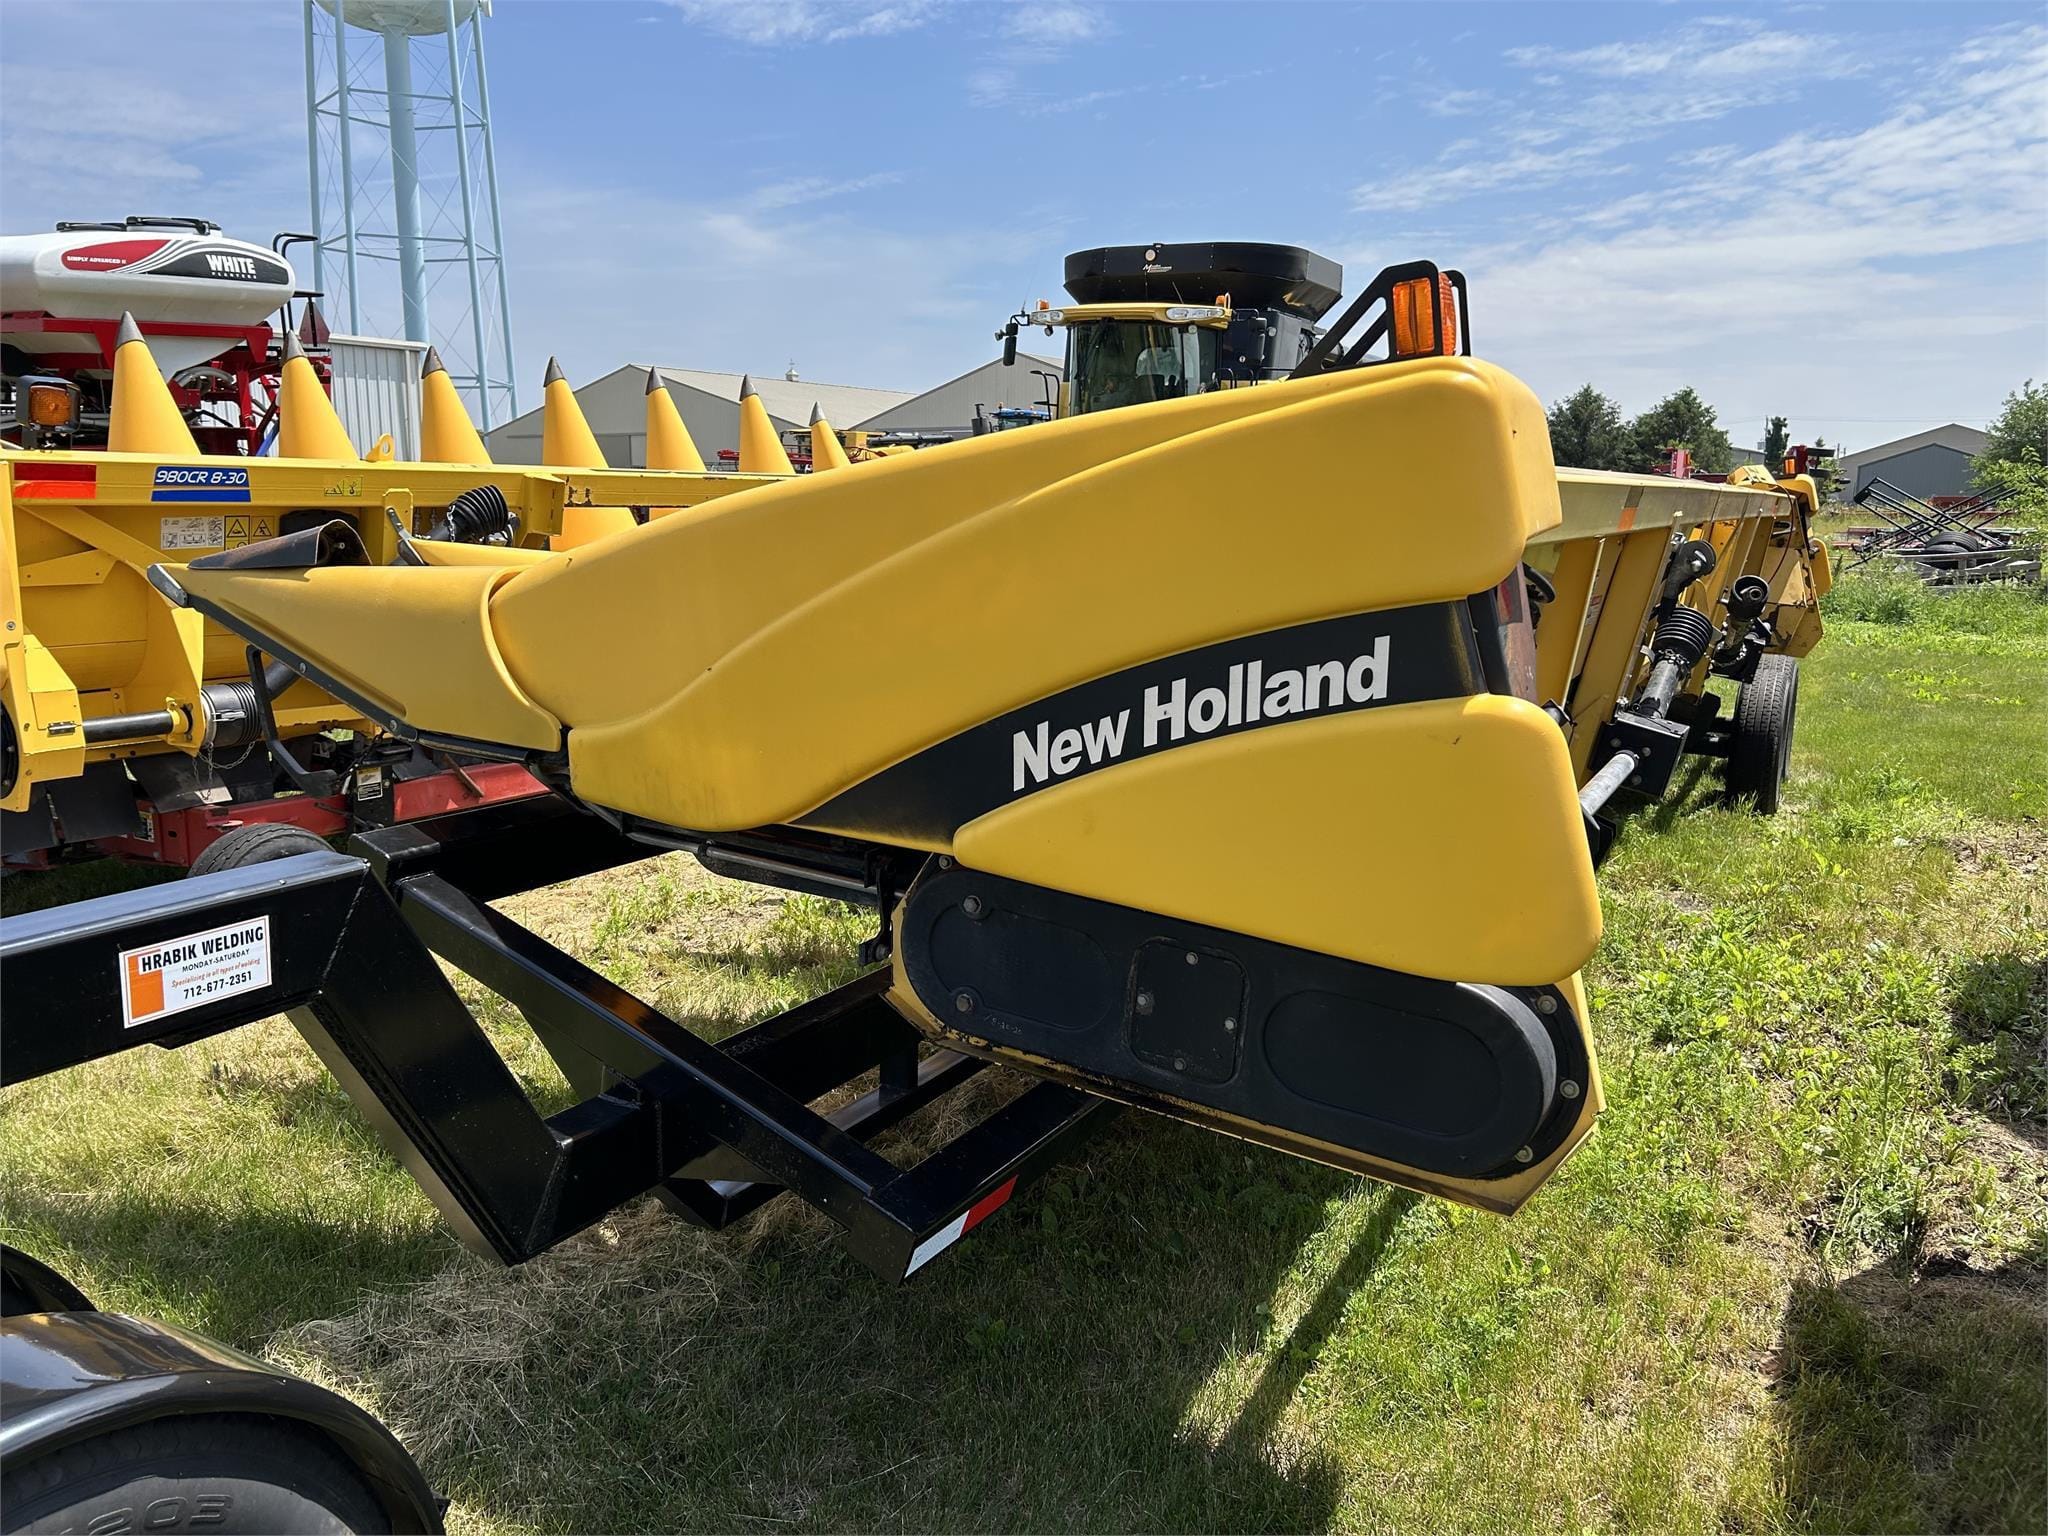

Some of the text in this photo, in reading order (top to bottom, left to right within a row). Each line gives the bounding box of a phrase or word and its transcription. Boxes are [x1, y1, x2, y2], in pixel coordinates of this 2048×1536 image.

[205, 254, 257, 274] WHITE
[155, 470, 247, 484] 980CR 8-30
[1013, 635, 1391, 792] New Holland
[141, 926, 264, 973] HRABIK WELDING
[182, 948, 250, 972] MONDAY-SATURDAY
[171, 973, 206, 989] Specializing
[212, 968, 220, 976] all
[240, 957, 261, 969] welding
[183, 971, 252, 1000] 712-677-2351
